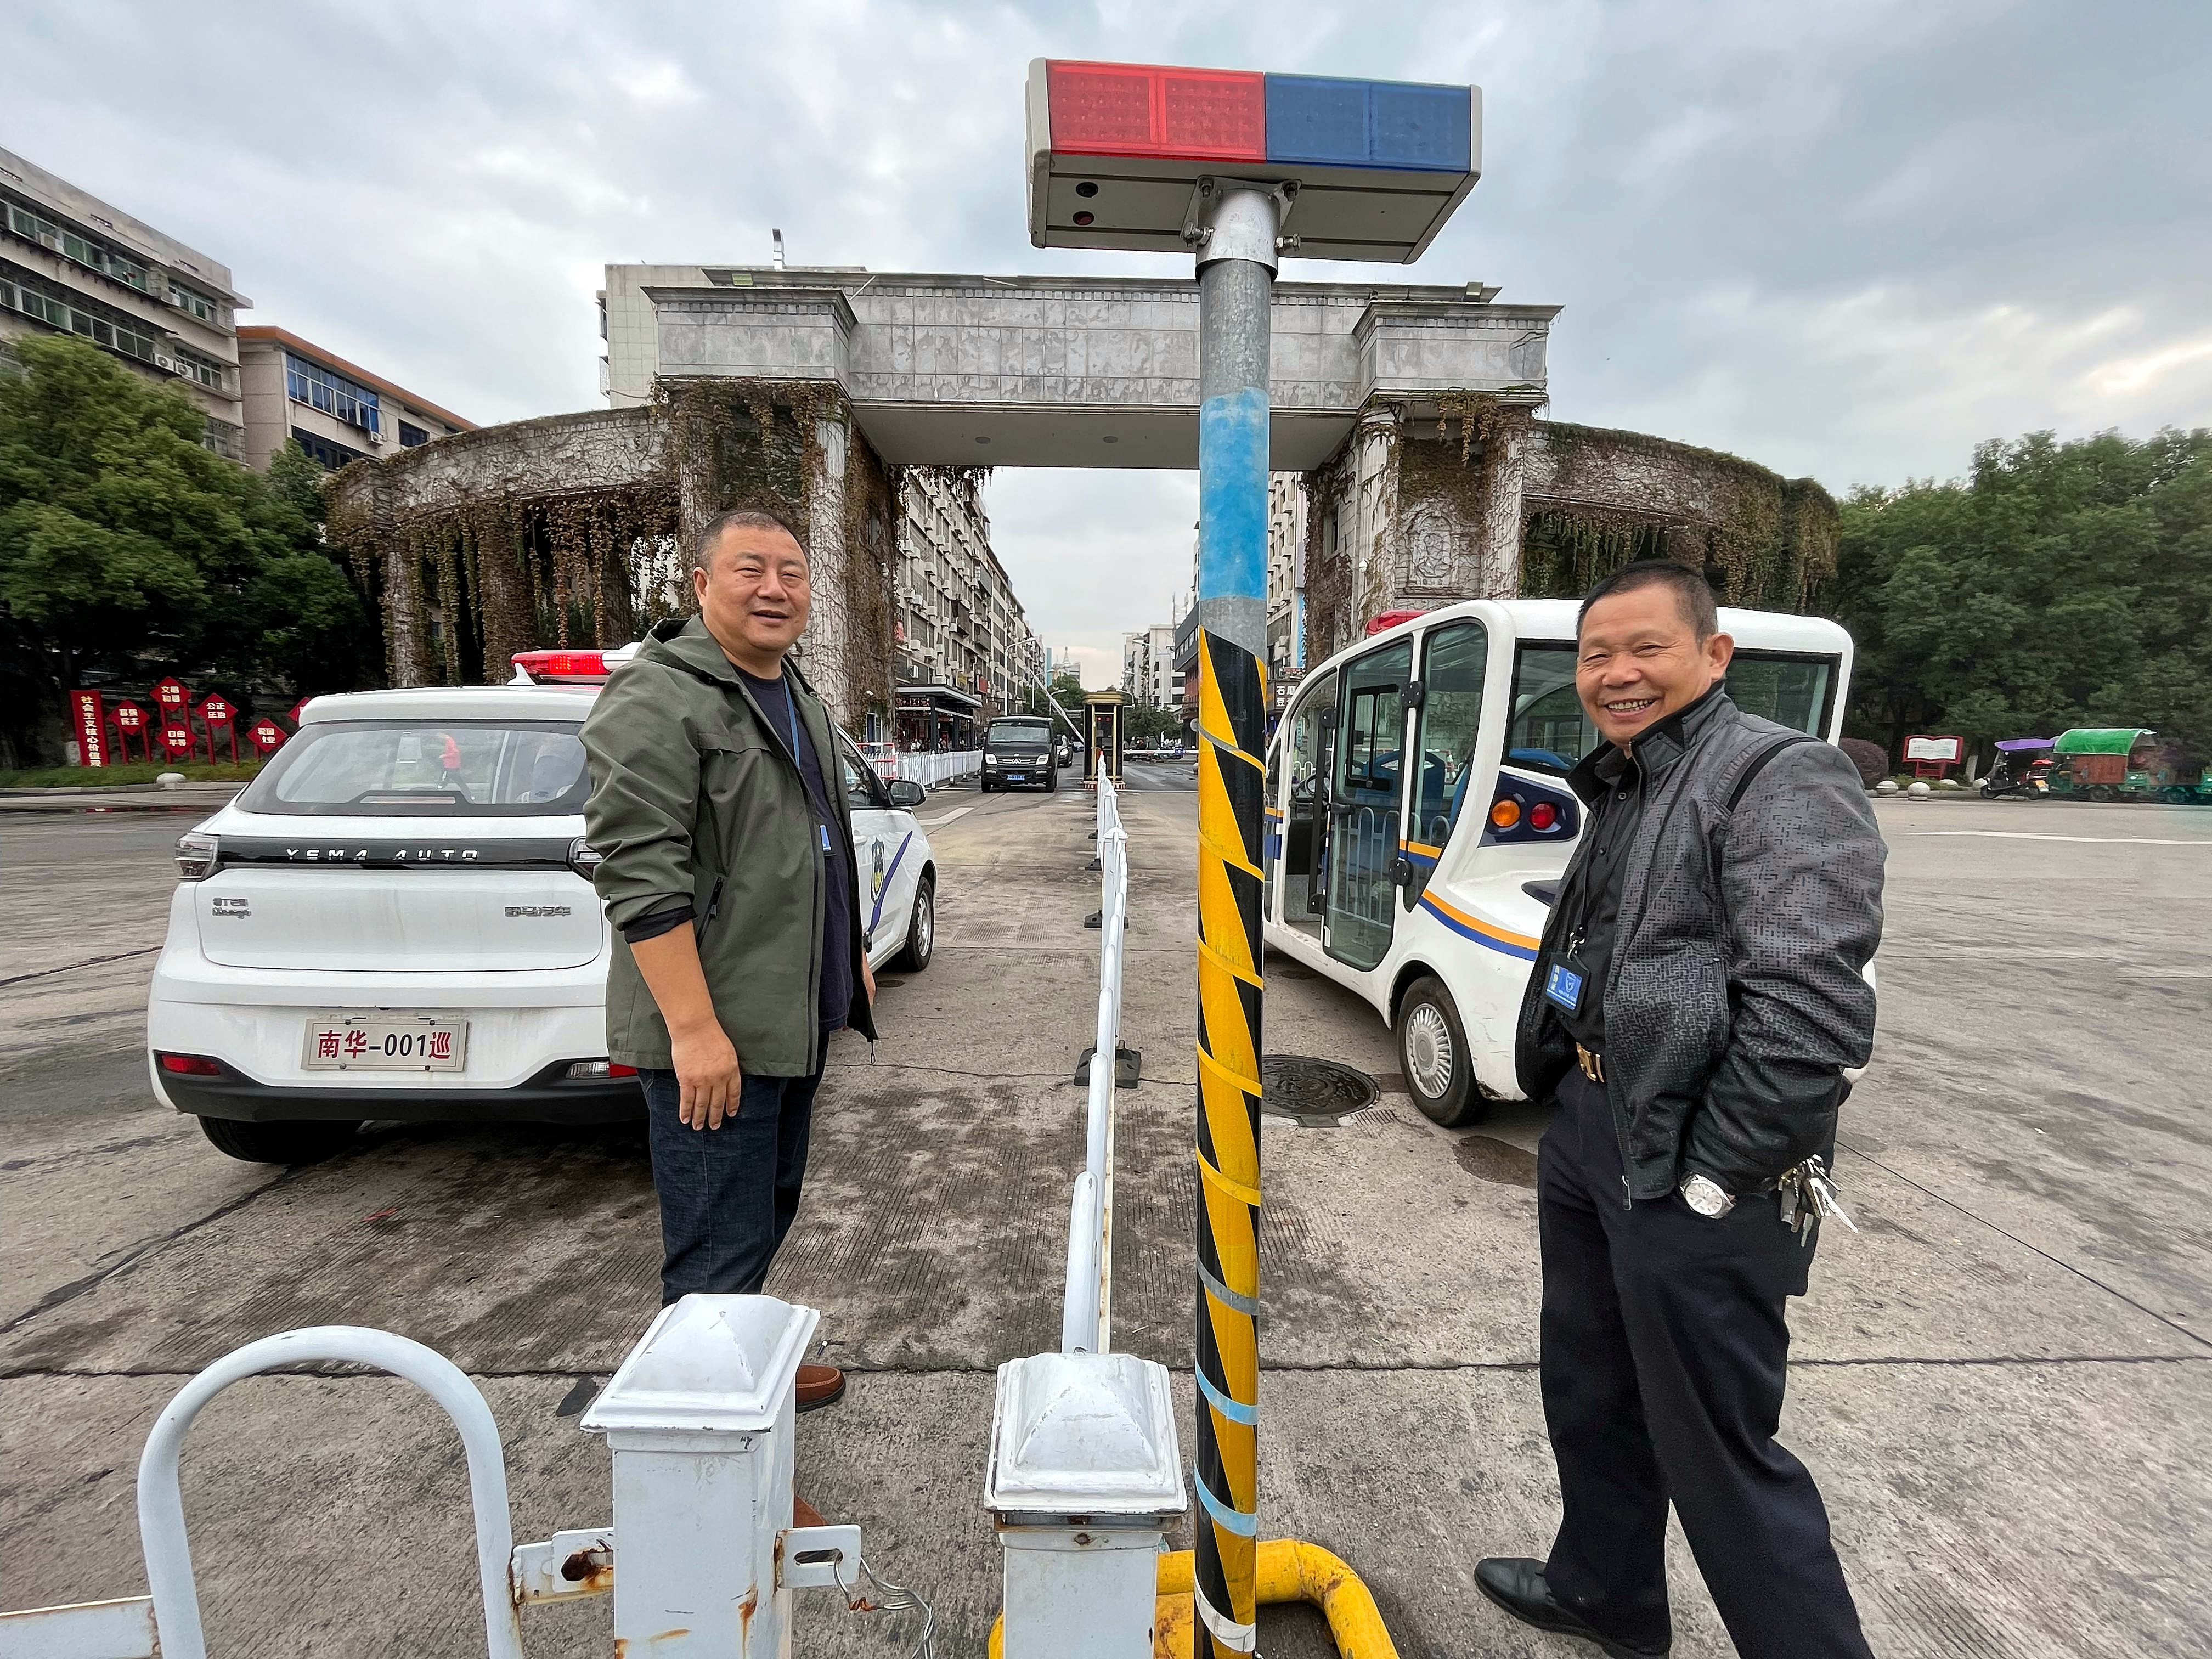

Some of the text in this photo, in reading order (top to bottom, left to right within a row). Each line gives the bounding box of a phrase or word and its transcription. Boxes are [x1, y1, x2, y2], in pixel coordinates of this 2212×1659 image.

[286, 849, 478, 861] YEMA AUTO
[318, 1029, 452, 1059] 南华-001巡
